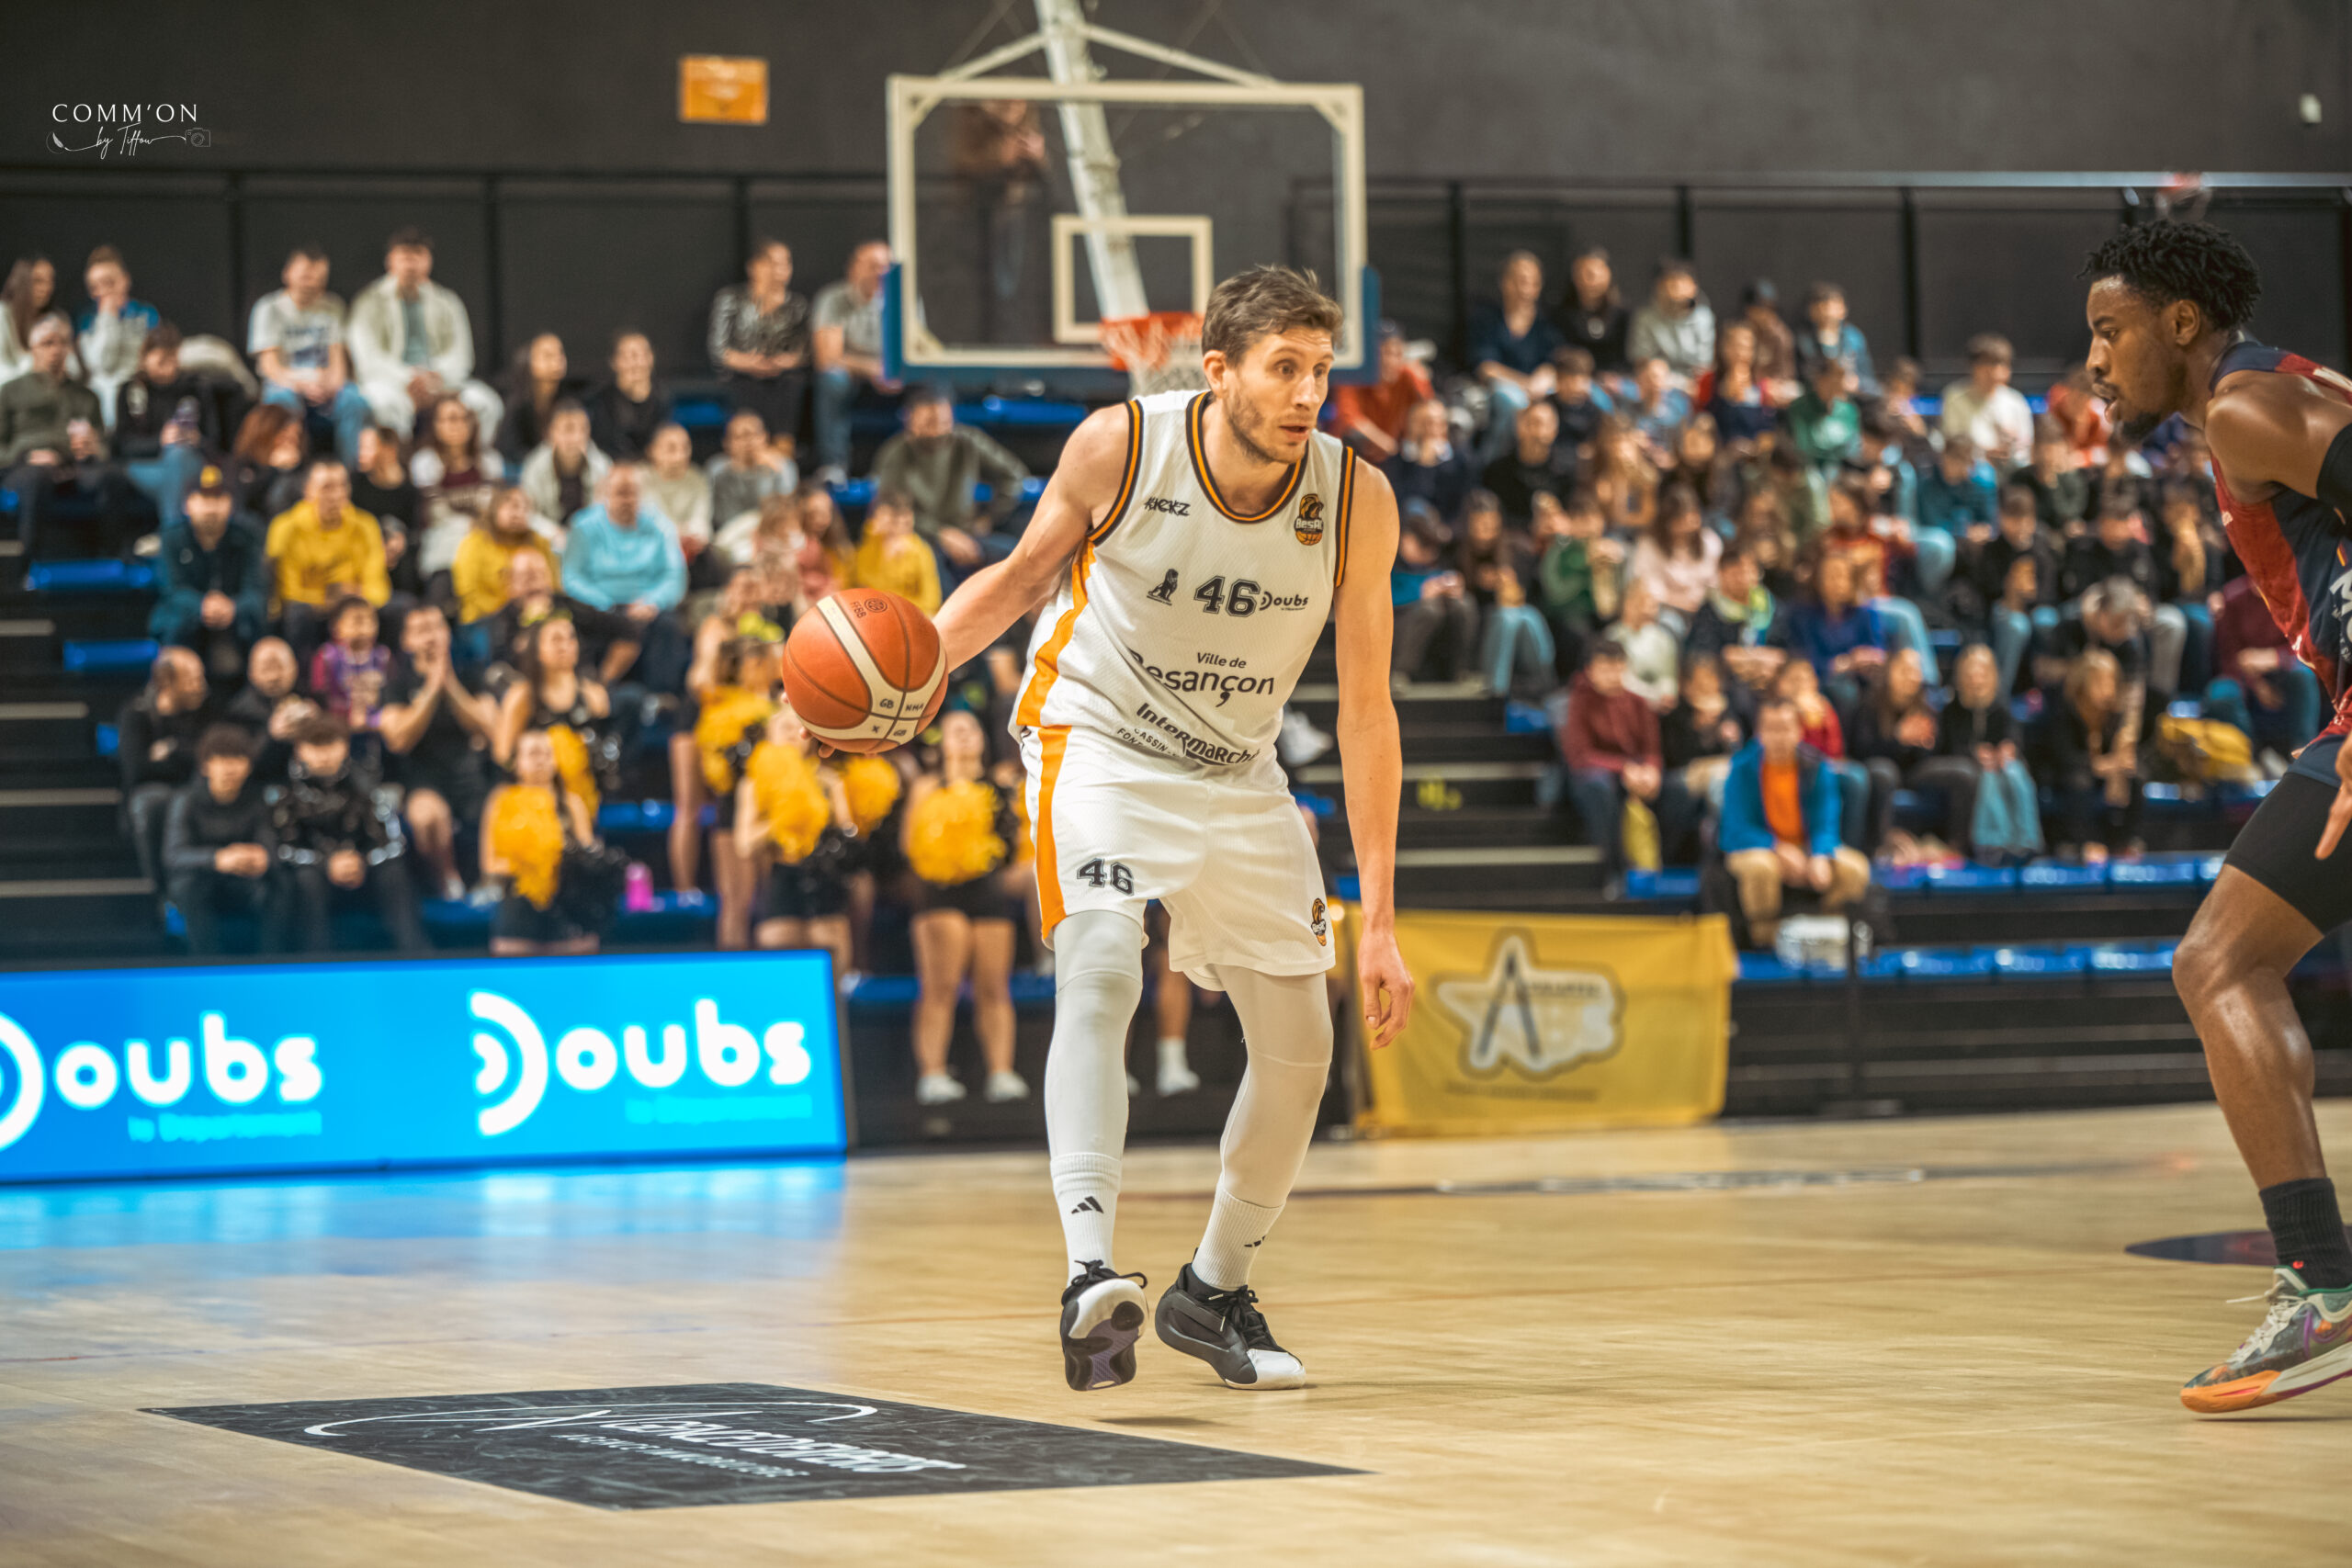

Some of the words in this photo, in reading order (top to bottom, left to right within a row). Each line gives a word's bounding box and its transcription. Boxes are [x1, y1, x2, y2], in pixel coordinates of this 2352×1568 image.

[1193, 575, 1261, 617] 46
[1259, 591, 1309, 611] Doubs
[1197, 652, 1227, 667] Ville
[1229, 657, 1247, 669] de
[1076, 858, 1135, 897] 46
[469, 990, 812, 1136] Doubs
